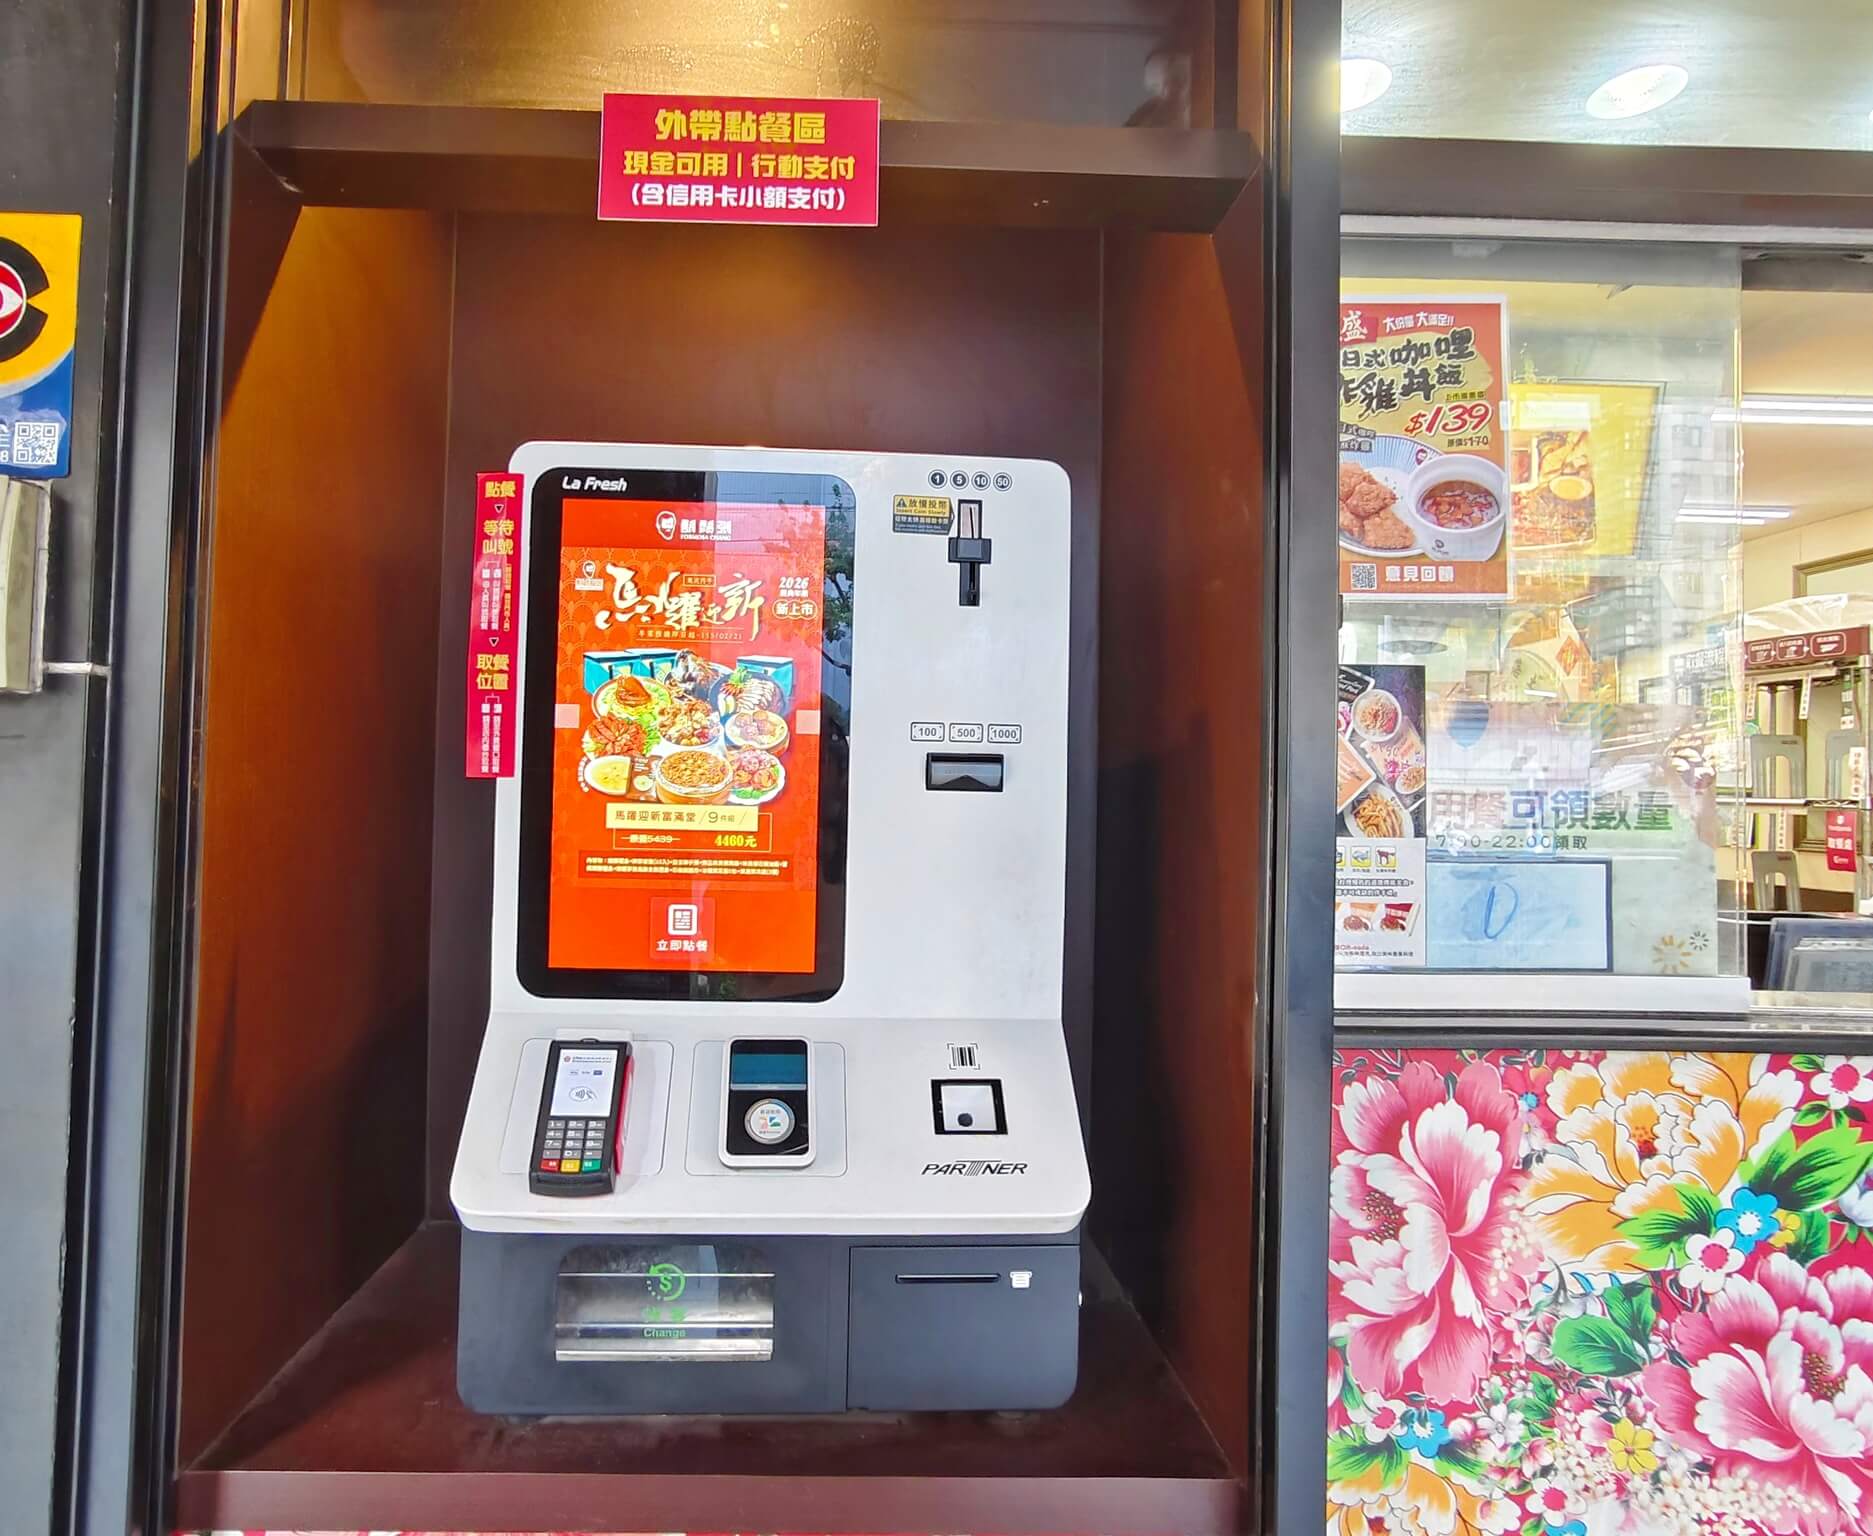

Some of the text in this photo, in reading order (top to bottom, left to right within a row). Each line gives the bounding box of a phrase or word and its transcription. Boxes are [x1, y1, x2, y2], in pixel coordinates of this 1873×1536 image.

[655, 109, 826, 144] 外帶點餐區
[623, 151, 728, 177] 現金可用
[751, 154, 855, 180] 行動支付
[631, 183, 846, 210] (含信用卡小額支付)
[1404, 403, 1491, 434] $139
[485, 481, 516, 498] 點餐
[562, 476, 628, 492] La Fresh
[976, 477, 987, 486] 10
[997, 478, 1009, 487] 50
[483, 519, 515, 537] 等待
[482, 538, 514, 555] 叫號
[779, 576, 810, 588] 2026
[775, 603, 814, 616] 新上市
[476, 654, 510, 671] 取餐
[476, 673, 509, 690] 位置
[919, 728, 1017, 739] 100 500 1000
[714, 834, 758, 848] 4460元
[656, 939, 708, 952] 立即點餐
[921, 1160, 1028, 1176] PARTNER
[643, 1327, 687, 1339] Change
